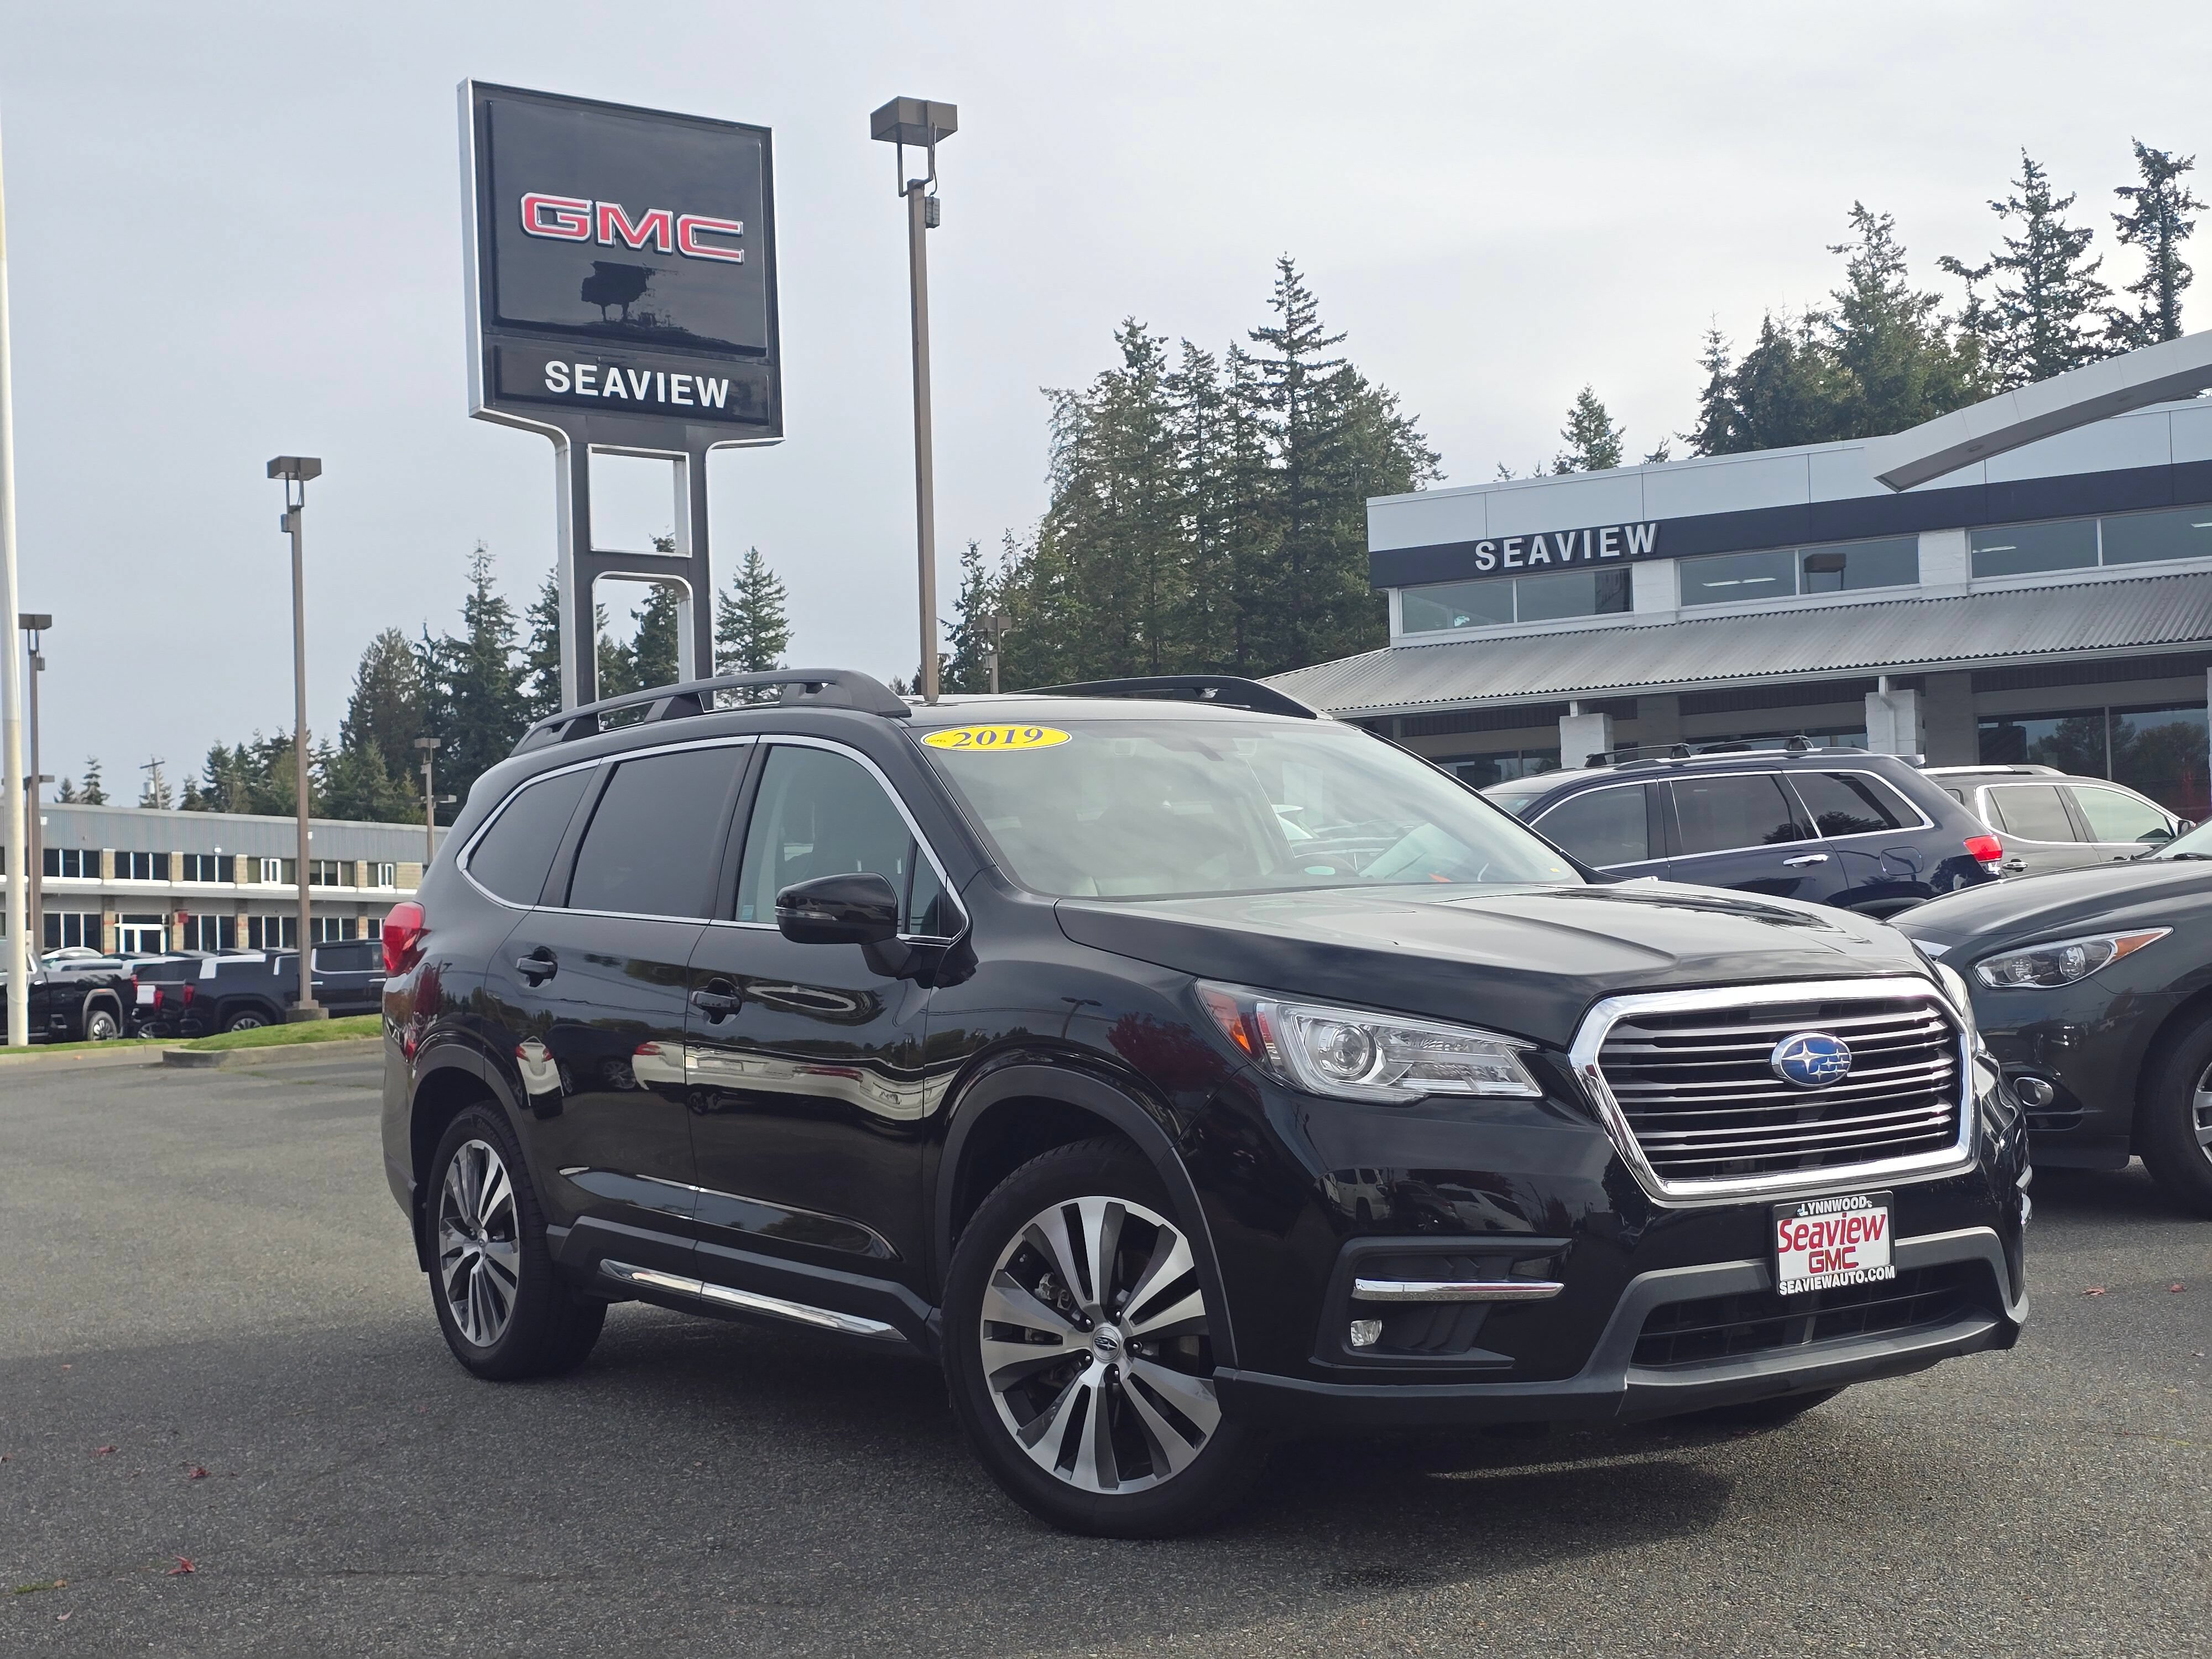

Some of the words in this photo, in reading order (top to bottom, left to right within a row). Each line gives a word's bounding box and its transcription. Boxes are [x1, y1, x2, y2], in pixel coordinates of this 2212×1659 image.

[520, 191, 744, 264] GMC
[544, 360, 729, 408] SEAVIEW
[1475, 523, 1658, 571] SEAVIEW
[951, 728, 1044, 747] 2019
[1799, 1196, 1867, 1217] LYNNWOOD
[1778, 1212, 1886, 1253] Seaview
[1808, 1246, 1859, 1274] GMC
[1779, 1265, 1895, 1296] SEAVIEWAUTO.COM
